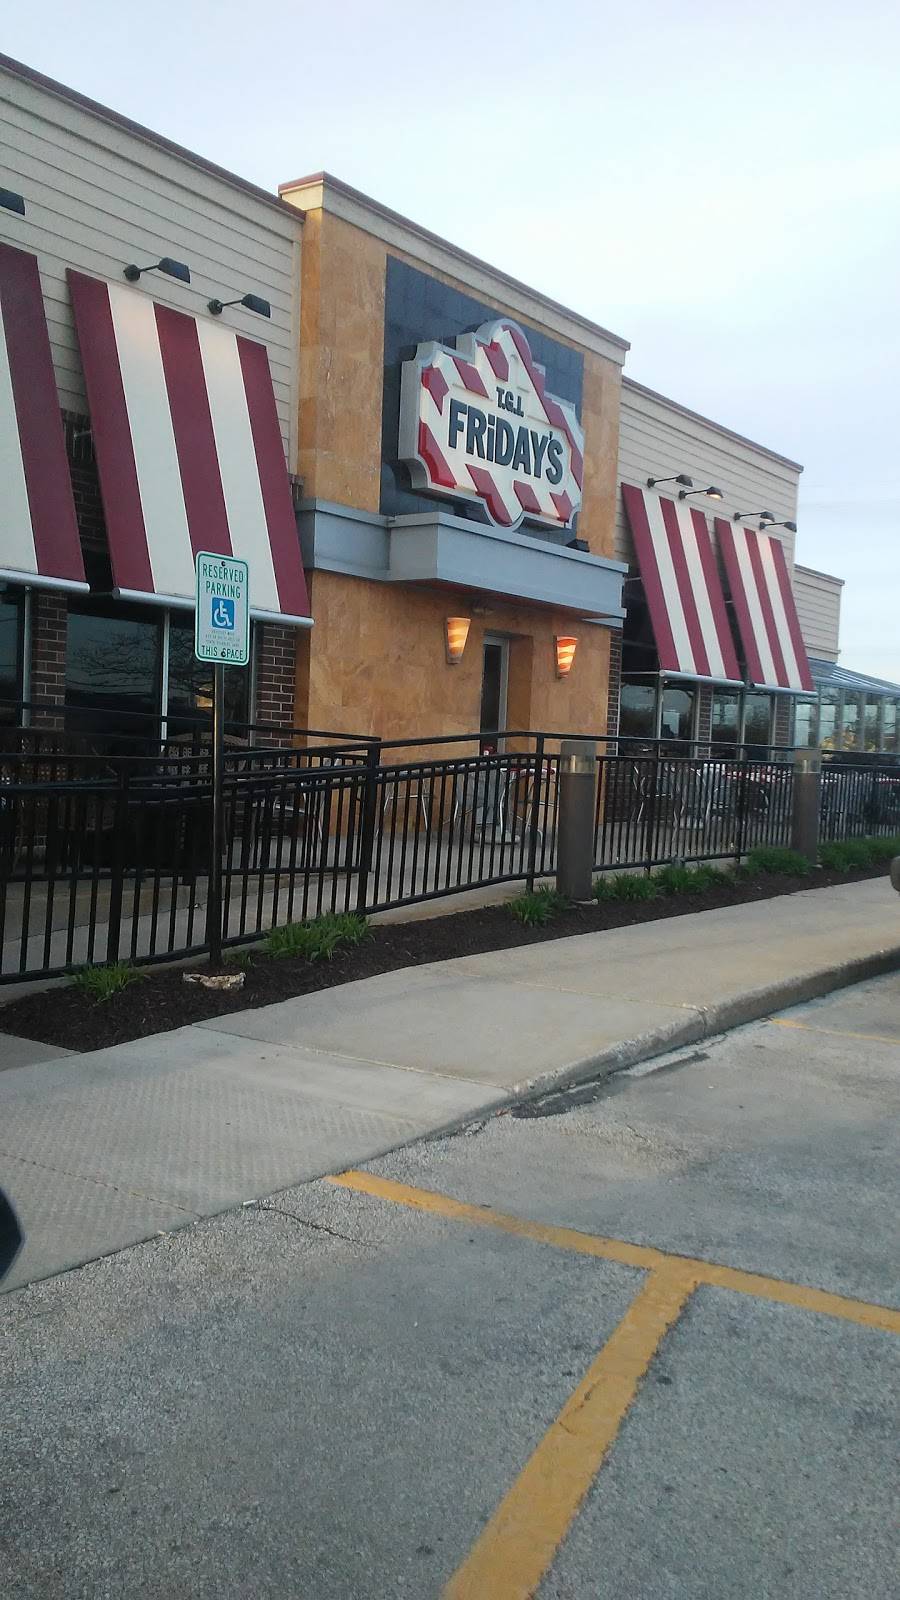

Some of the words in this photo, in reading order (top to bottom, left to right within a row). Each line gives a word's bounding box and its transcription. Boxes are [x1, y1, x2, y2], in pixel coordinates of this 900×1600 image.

[496, 386, 524, 418] T.G.I.
[202, 563, 244, 583] RESERVED
[205, 580, 241, 599] PARKING
[201, 645, 218, 657] THIS
[221, 646, 244, 660] SPACE
